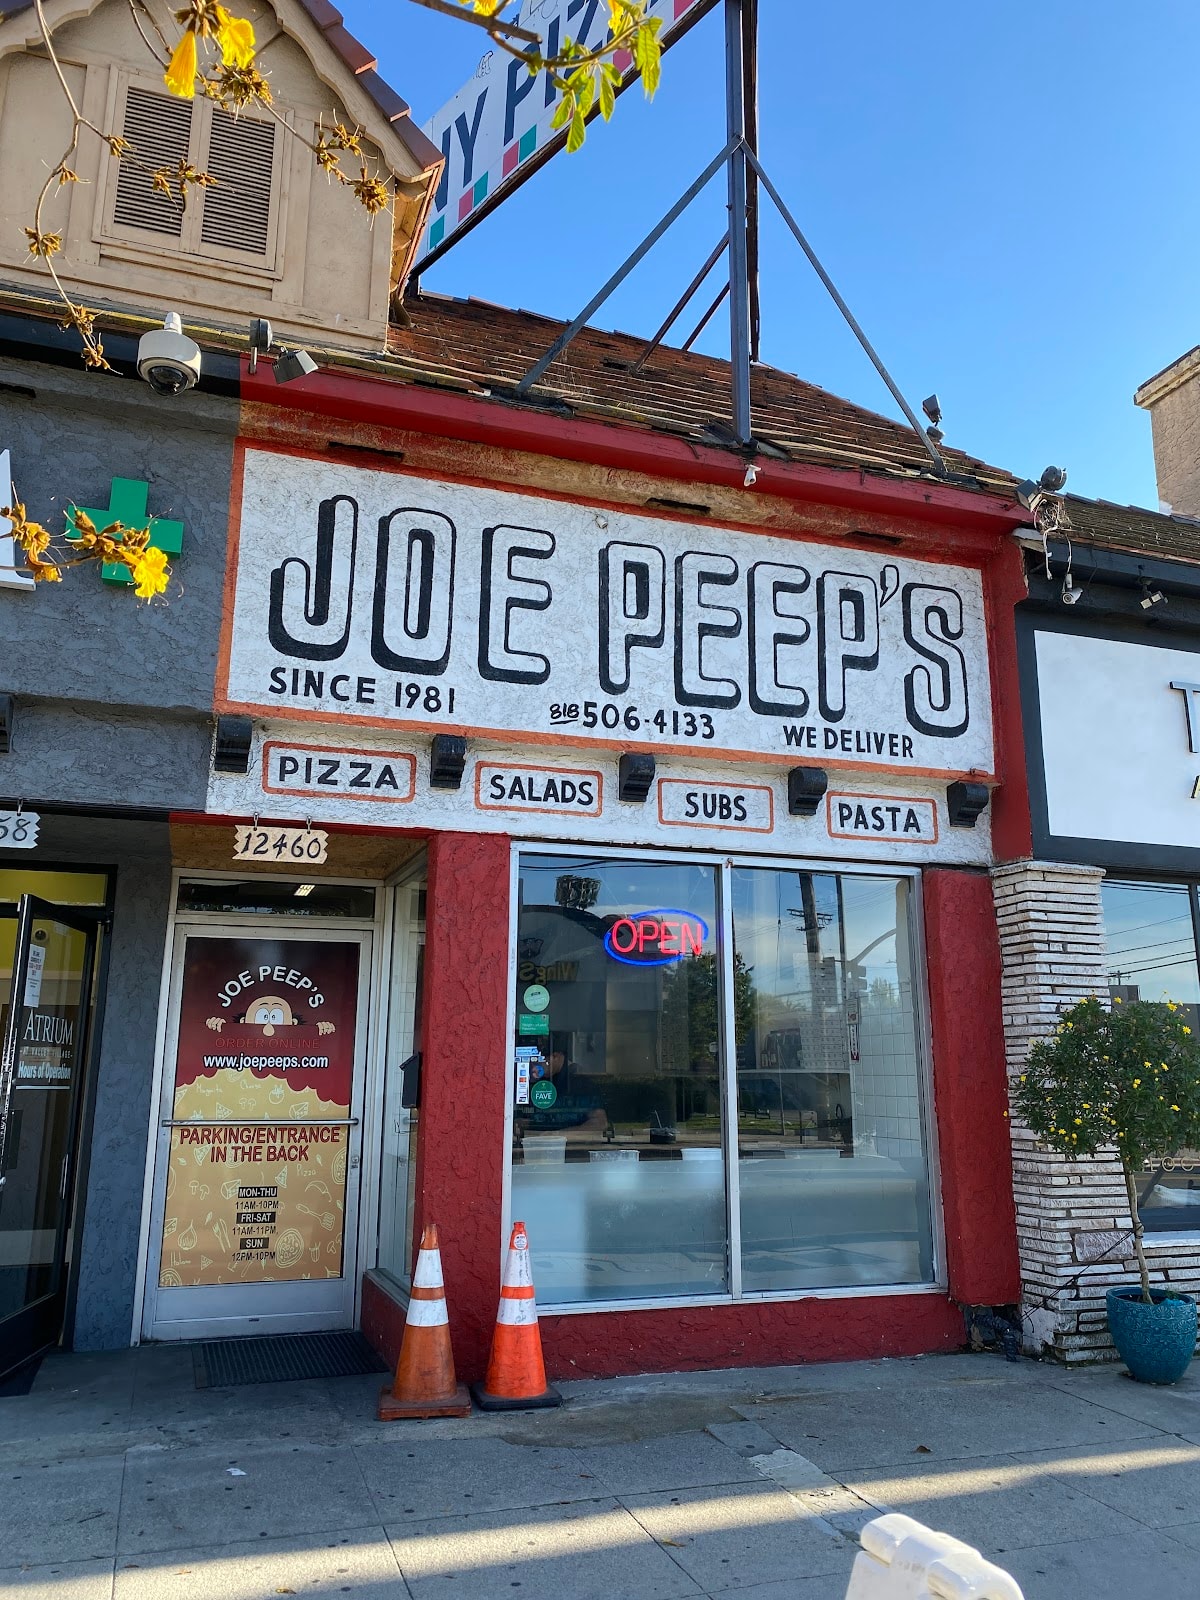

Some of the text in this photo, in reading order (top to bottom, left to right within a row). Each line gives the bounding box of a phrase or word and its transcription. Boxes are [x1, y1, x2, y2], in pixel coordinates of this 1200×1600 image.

[268, 494, 970, 738] JOE PEEP'S
[268, 666, 455, 714] SINCE 1981
[583, 701, 715, 740] 506-4133
[782, 725, 914, 758] WE DELIVER
[279, 755, 399, 790] PIZZA
[489, 774, 593, 806] SALADS
[685, 792, 747, 821] SUBS
[838, 802, 921, 833] PASTA
[240, 832, 321, 859] 12460
[612, 918, 702, 955] OPEN
[217, 965, 325, 1008] JOE PEEP'S
[215, 1038, 320, 1050] ORDER ONLINE
[18, 1061, 37, 1078] Hours
[204, 1052, 328, 1071] www.joepeeps.com
[535, 1092, 552, 1100] FAVE
[180, 1126, 341, 1144] PARKING/ENTRANCE
[211, 1145, 309, 1162] IN THE BACK
[239, 1187, 277, 1197] MON-THU
[236, 1201, 279, 1210] 11AM-10PM
[241, 1213, 271, 1223] FRI-SAT
[245, 1239, 263, 1248] SUN
[232, 1252, 275, 1261] 12PM-10PM
